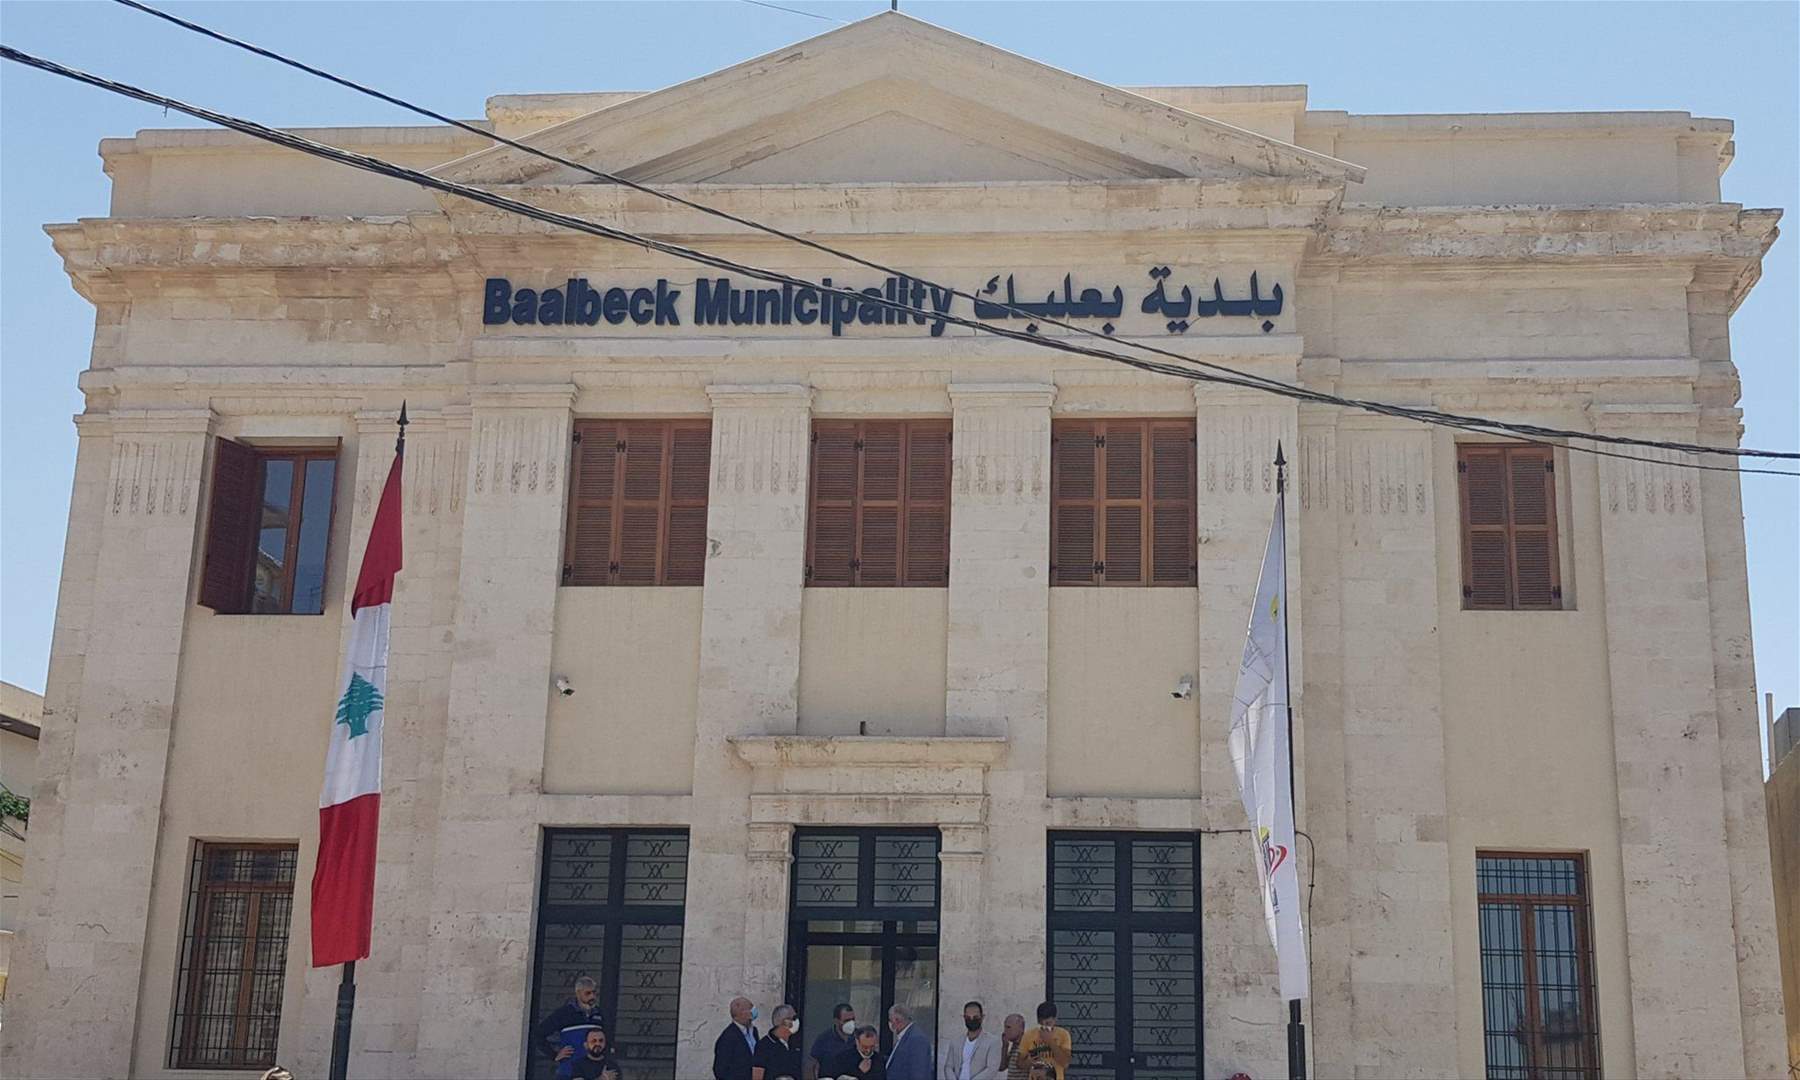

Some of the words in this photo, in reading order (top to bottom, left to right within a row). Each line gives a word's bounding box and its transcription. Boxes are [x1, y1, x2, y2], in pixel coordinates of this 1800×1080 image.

[483, 278, 681, 326] Baalbeck
[695, 278, 953, 336] Municipality
[974, 272, 1123, 335] بعلبك
[1141, 266, 1283, 334] بلدية
